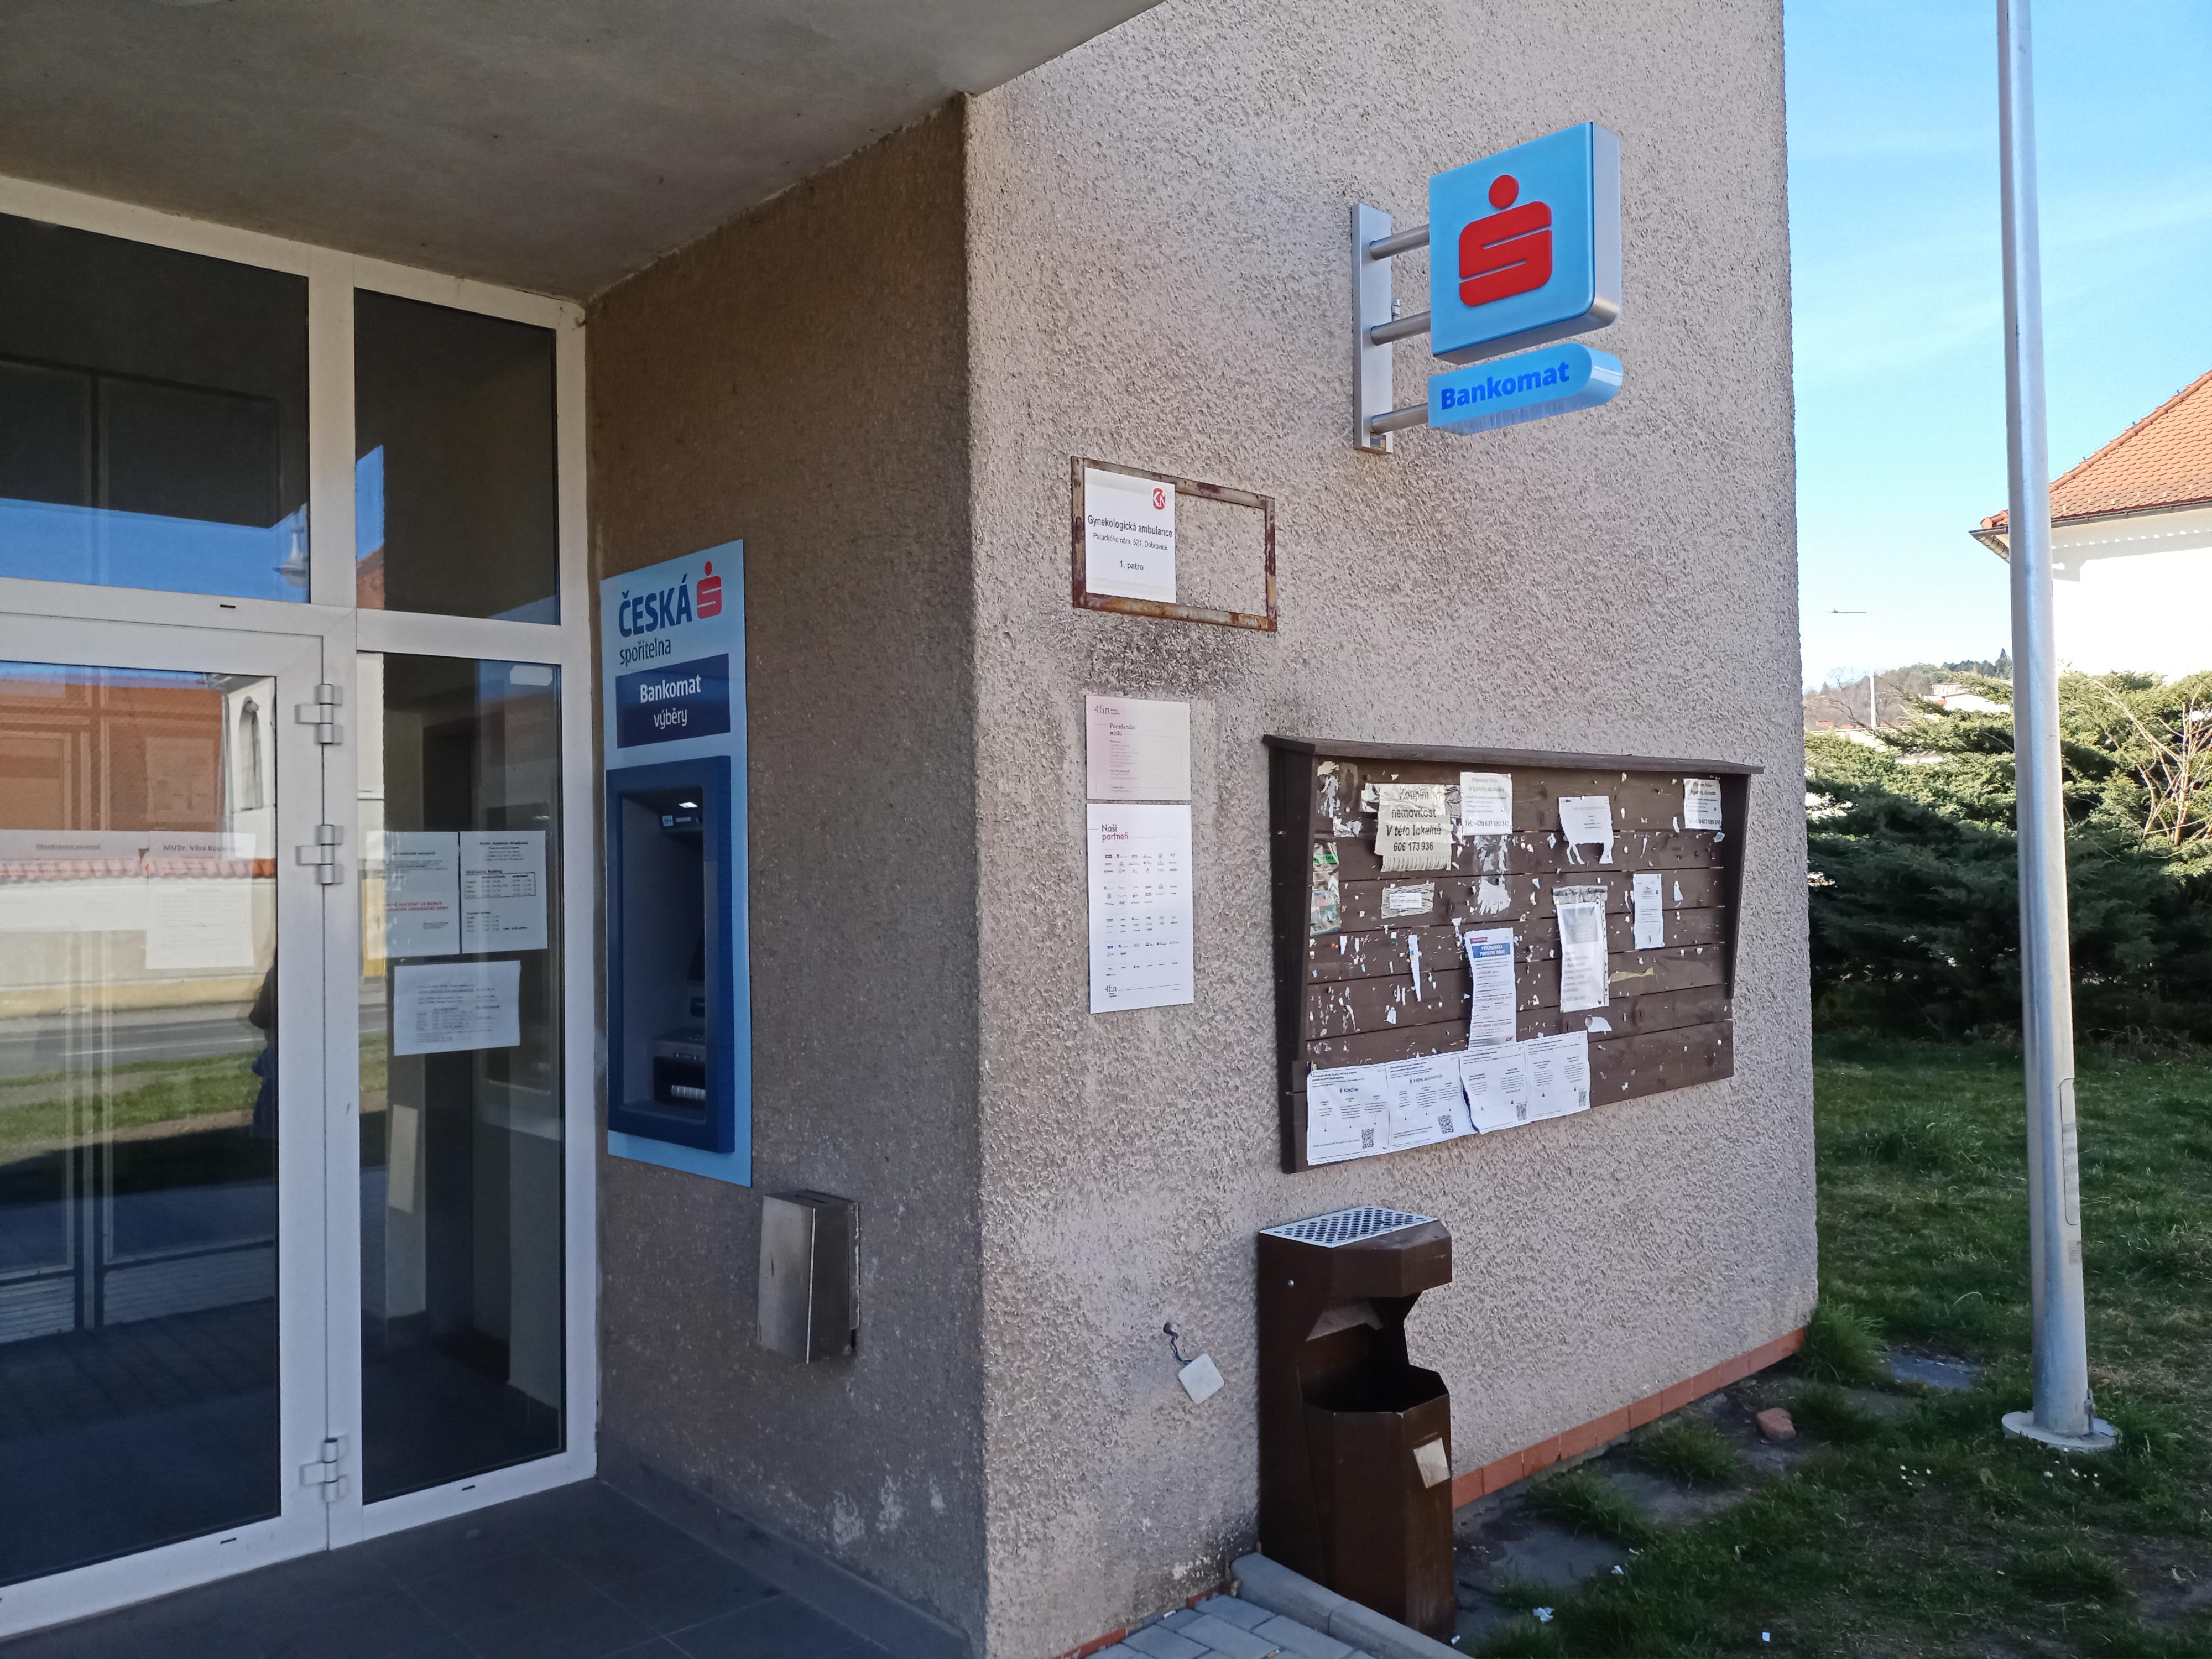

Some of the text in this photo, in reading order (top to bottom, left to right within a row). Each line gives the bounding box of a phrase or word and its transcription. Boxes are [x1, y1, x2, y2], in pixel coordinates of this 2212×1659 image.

[1441, 361, 1569, 409] Bankomat
[1088, 514, 1172, 538] Gynekologická ambulance
[1093, 532, 1119, 543] Palackého
[1120, 536, 1132, 545] nám.
[1144, 540, 1168, 550] Dobrovice
[1127, 561, 1144, 571] patro
[619, 573, 692, 638] ČESKÁ
[620, 638, 671, 667] spořitelna
[640, 674, 701, 703] Bankomat
[654, 708, 687, 729] výběry
[1391, 807, 1436, 818] nemovitost
[1102, 823, 1117, 832] Naši
[1386, 825, 1393, 836] V
[1394, 825, 1410, 836] této
[1102, 832, 1129, 843] partneři
[1393, 841, 1433, 852] 606 173 936
